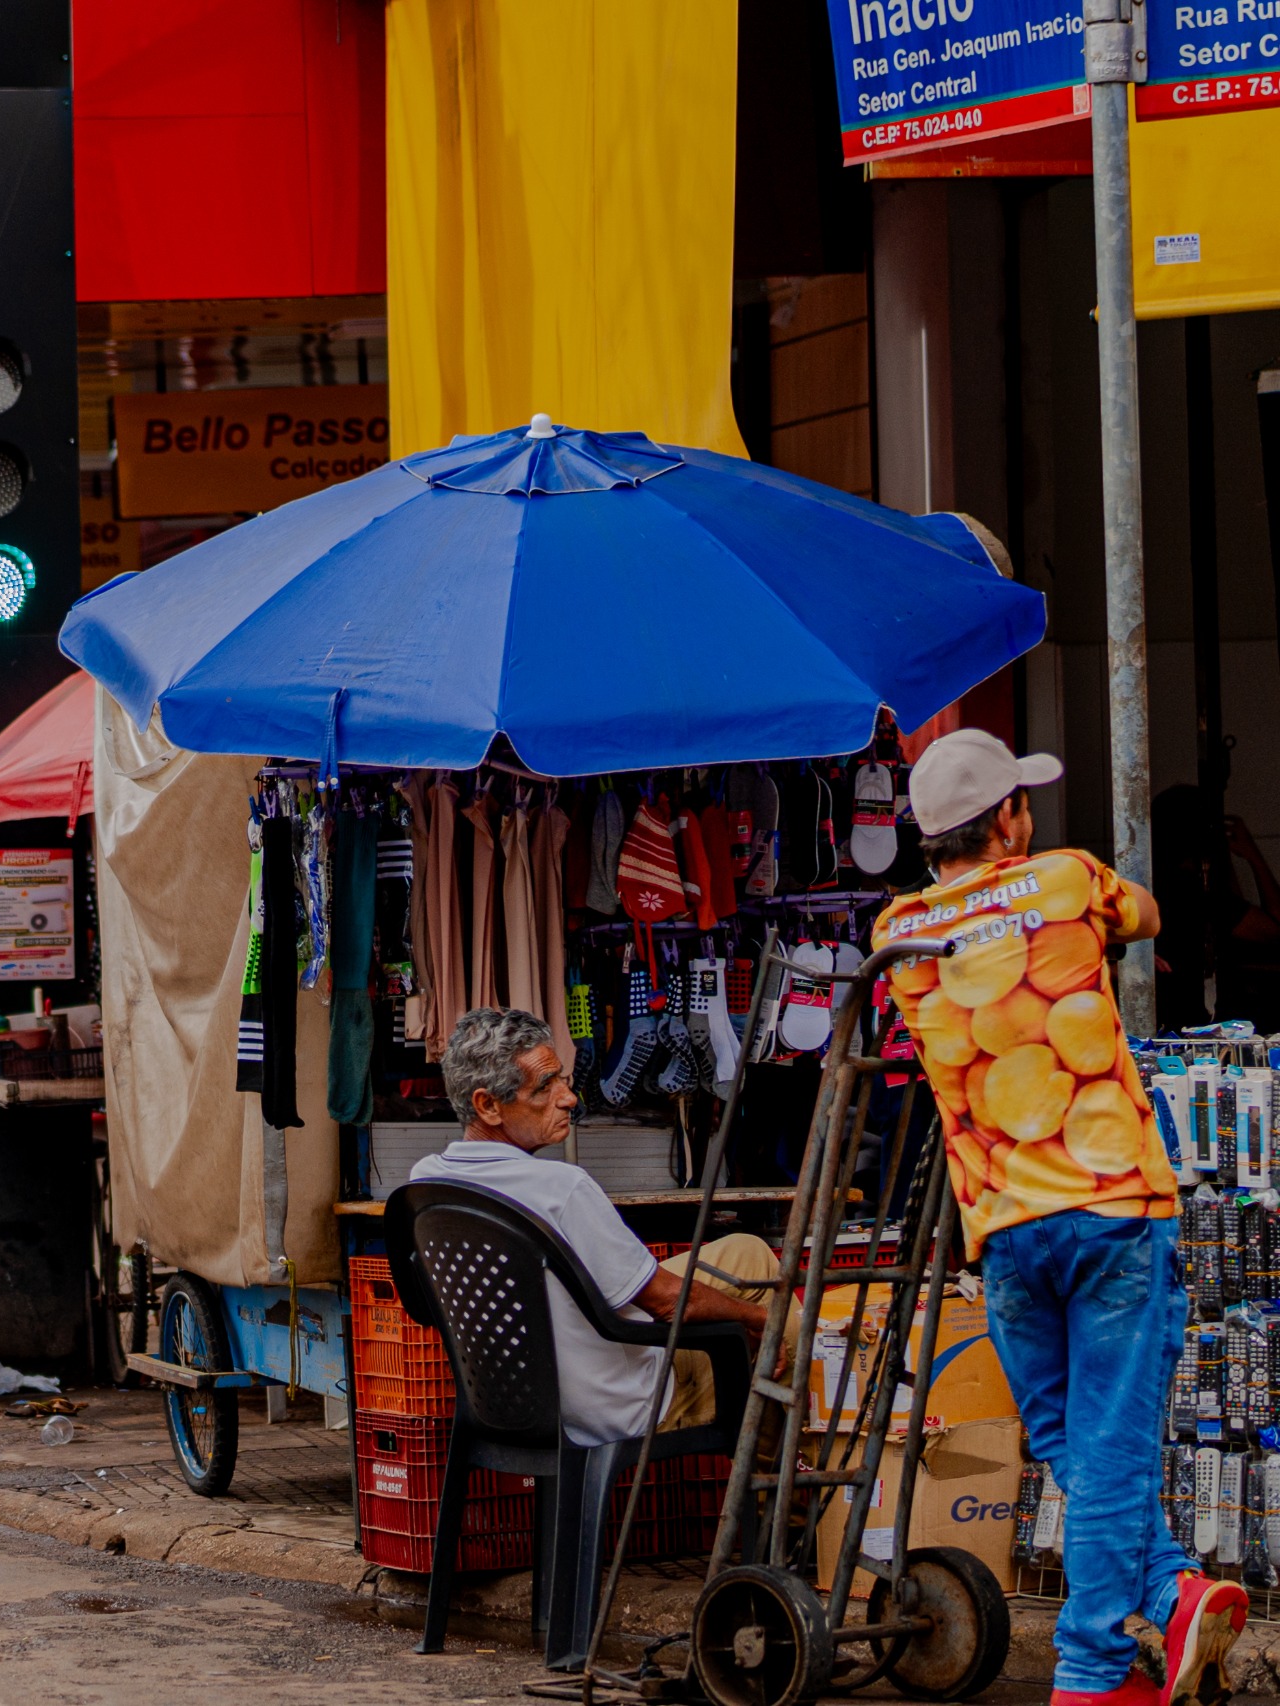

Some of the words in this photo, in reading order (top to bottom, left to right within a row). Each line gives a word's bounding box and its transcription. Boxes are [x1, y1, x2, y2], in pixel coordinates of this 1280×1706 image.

[1175, 6, 1228, 30] Rua
[853, 57, 889, 80] Rua
[893, 49, 936, 72] Gen.
[941, 29, 1021, 62] Joaquim
[1025, 13, 1084, 43] Inacio
[1179, 41, 1252, 67] Setor
[1259, 33, 1280, 58] C
[858, 90, 906, 116] Setor
[911, 70, 977, 104] Central
[1172, 80, 1241, 104] C.E.P.:
[1247, 76, 1280, 97] 75.
[904, 108, 983, 141] 75.024-040
[144, 416, 250, 454] Bello
[263, 413, 390, 449] Passo
[887, 903, 959, 940] Lerdo
[963, 872, 1040, 916] Piqui
